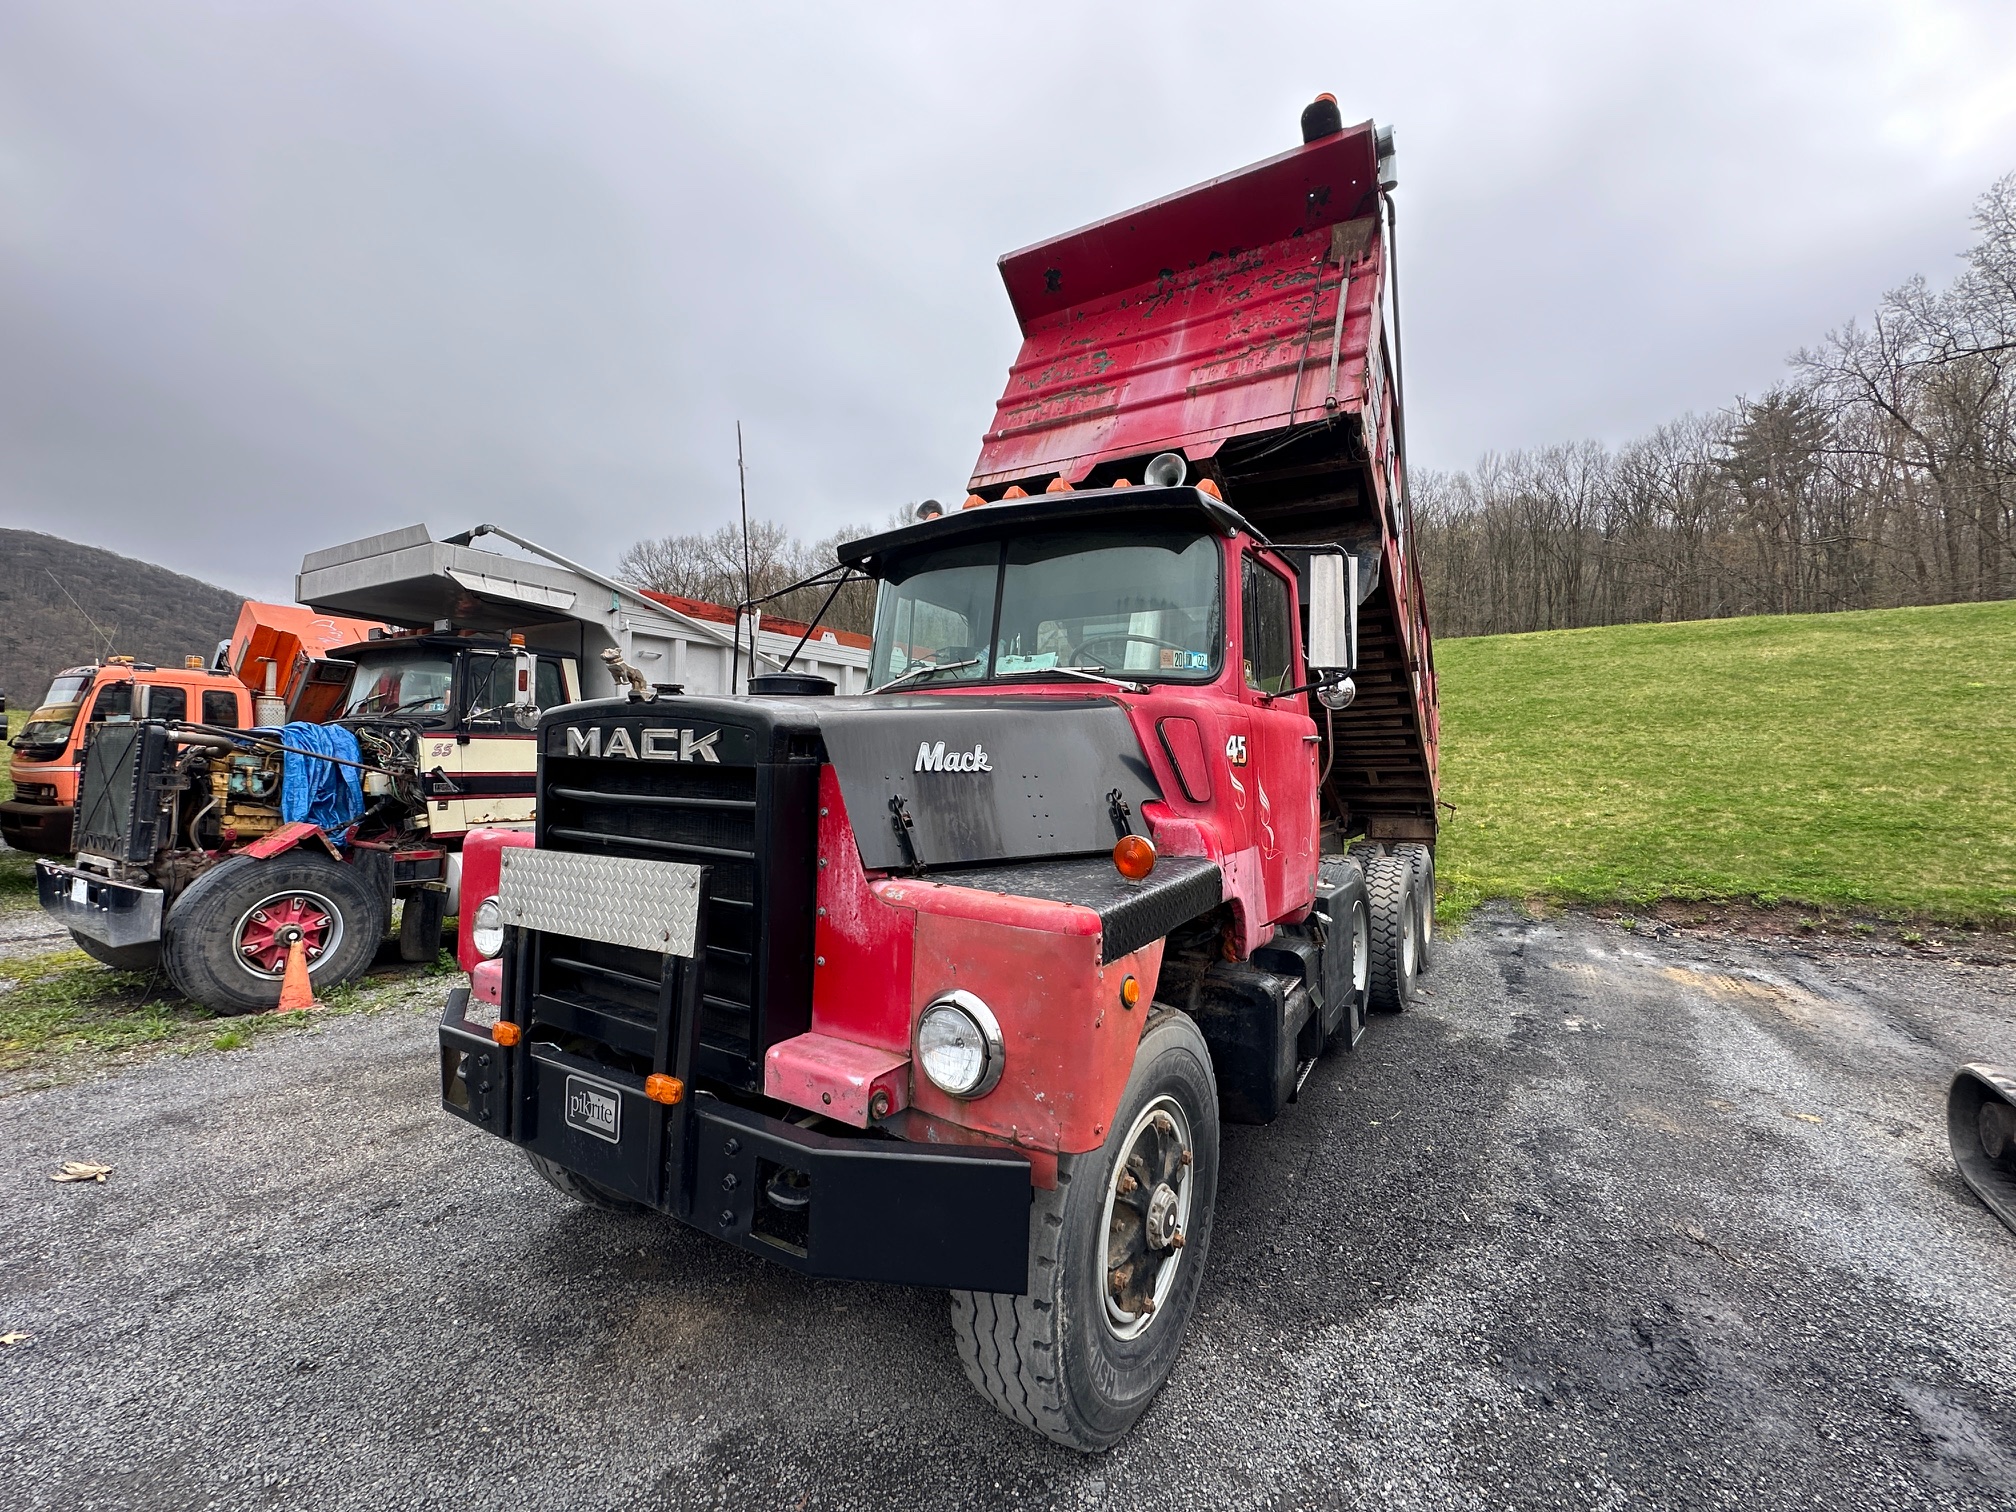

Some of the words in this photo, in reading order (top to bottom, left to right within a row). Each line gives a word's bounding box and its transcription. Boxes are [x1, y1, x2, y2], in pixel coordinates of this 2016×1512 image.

[567, 727, 722, 764] MACK
[914, 741, 993, 772] Mack
[1225, 735, 1248, 767] 45
[569, 1090, 613, 1124] pikrite
